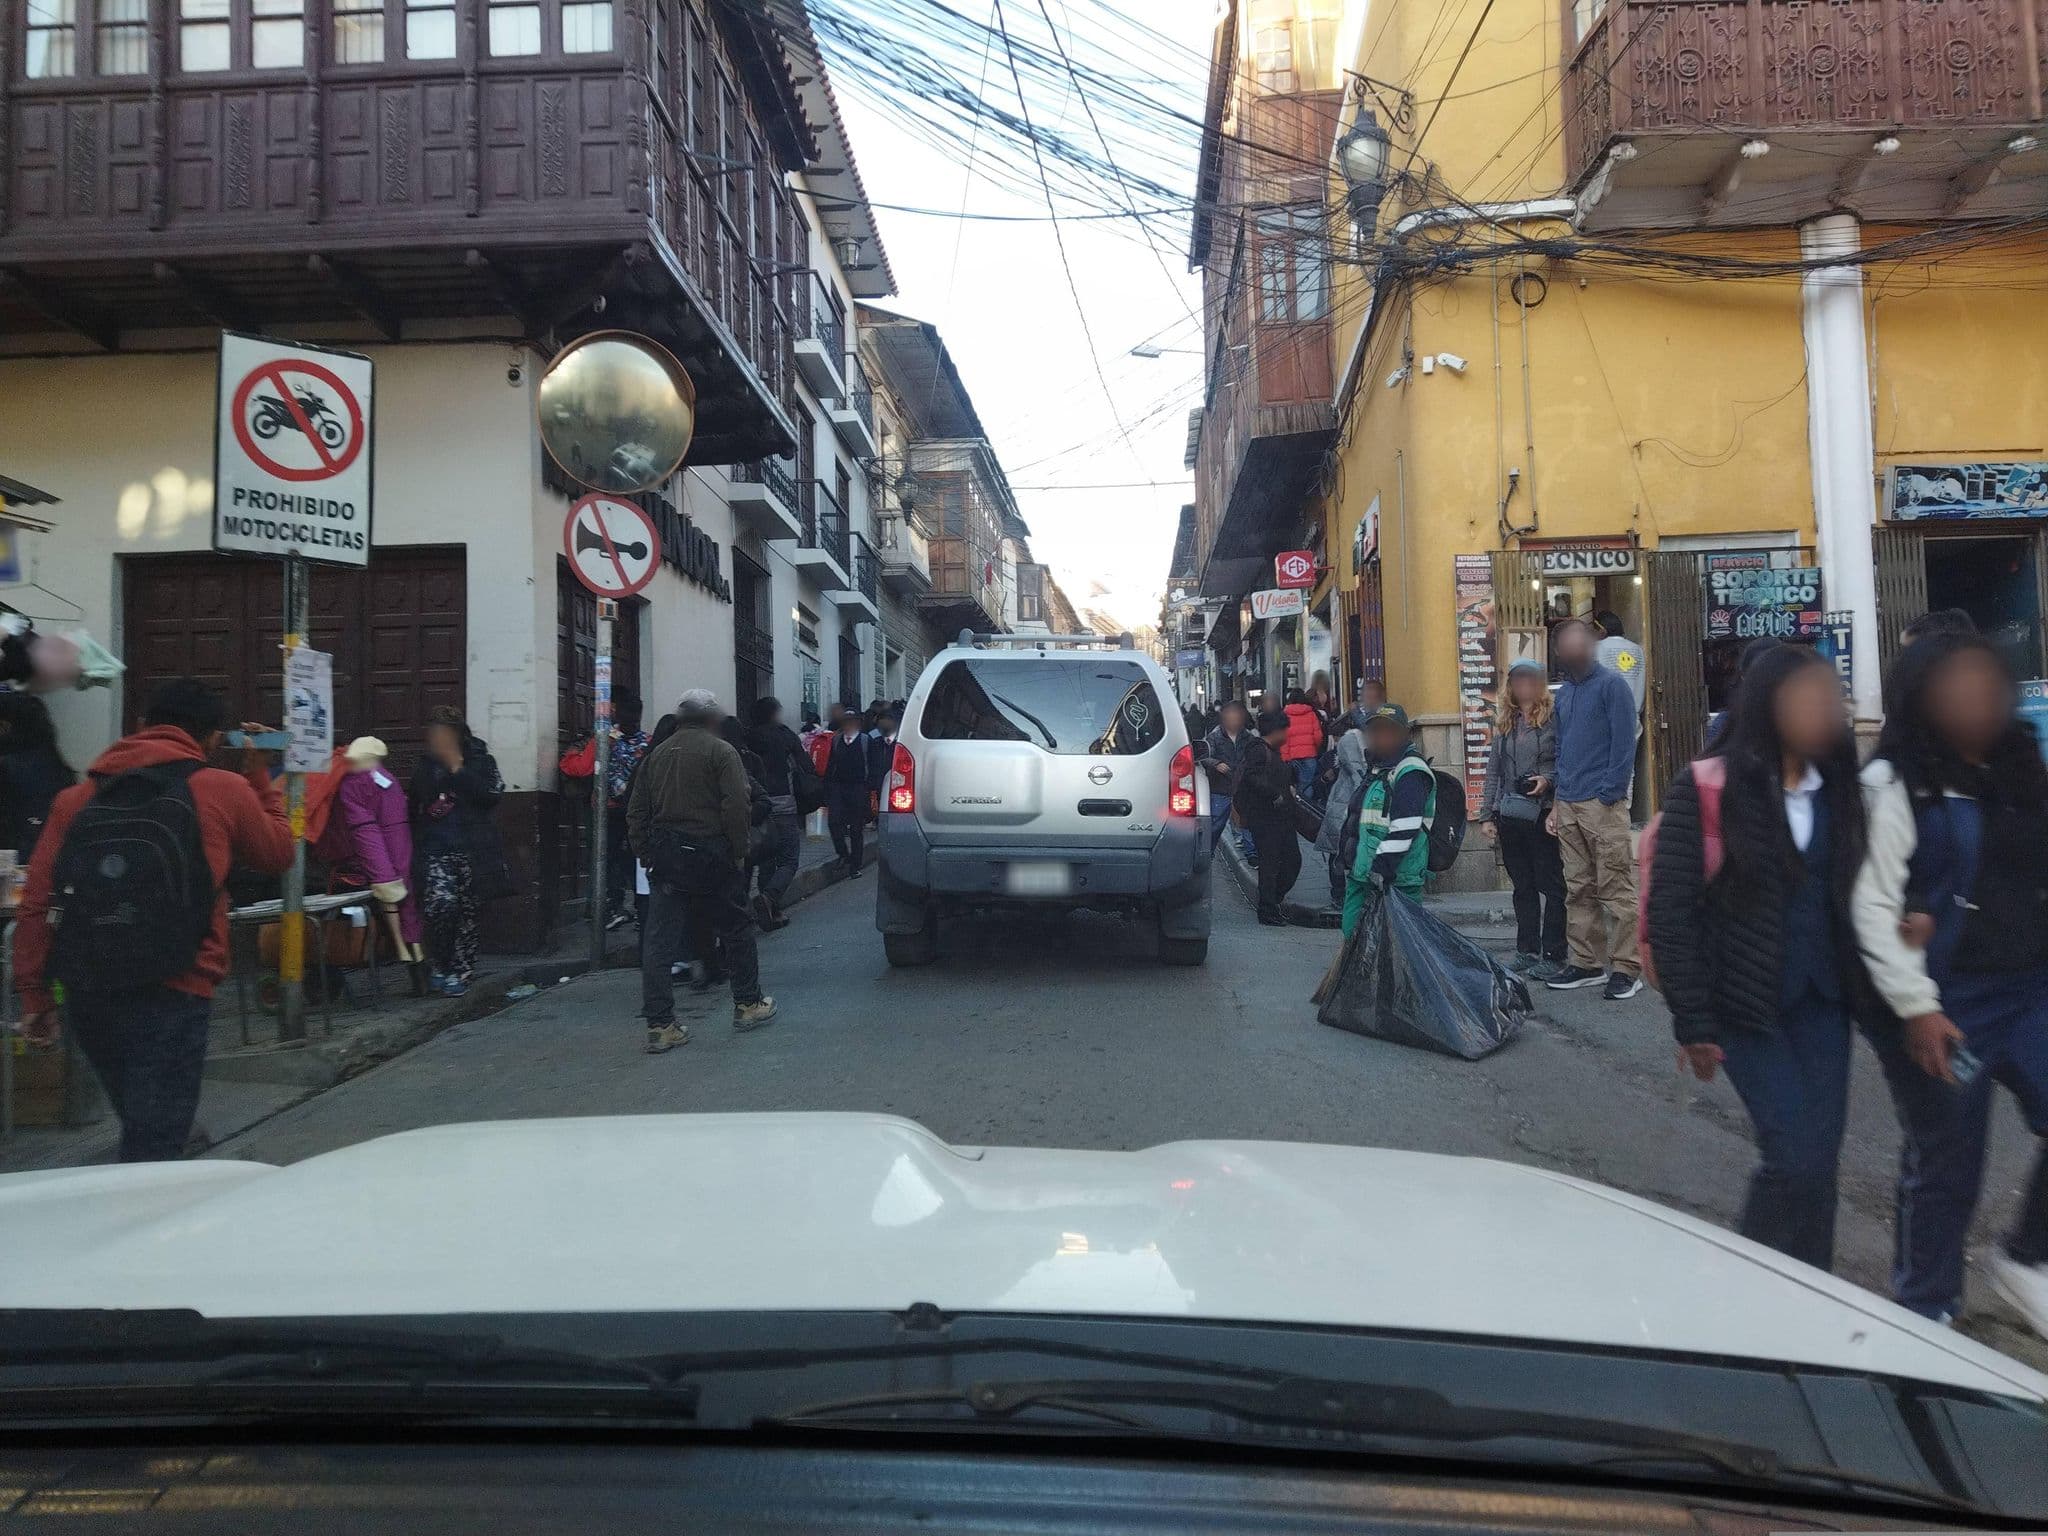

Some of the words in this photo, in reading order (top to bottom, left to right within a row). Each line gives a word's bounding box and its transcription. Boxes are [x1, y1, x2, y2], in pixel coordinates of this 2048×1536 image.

[232, 487, 355, 520] PROHIBIDO
[224, 516, 364, 549] MOTOCICLETAS
[1712, 557, 1764, 568] SERVICIO
[1711, 569, 1820, 588] SOPORTE
